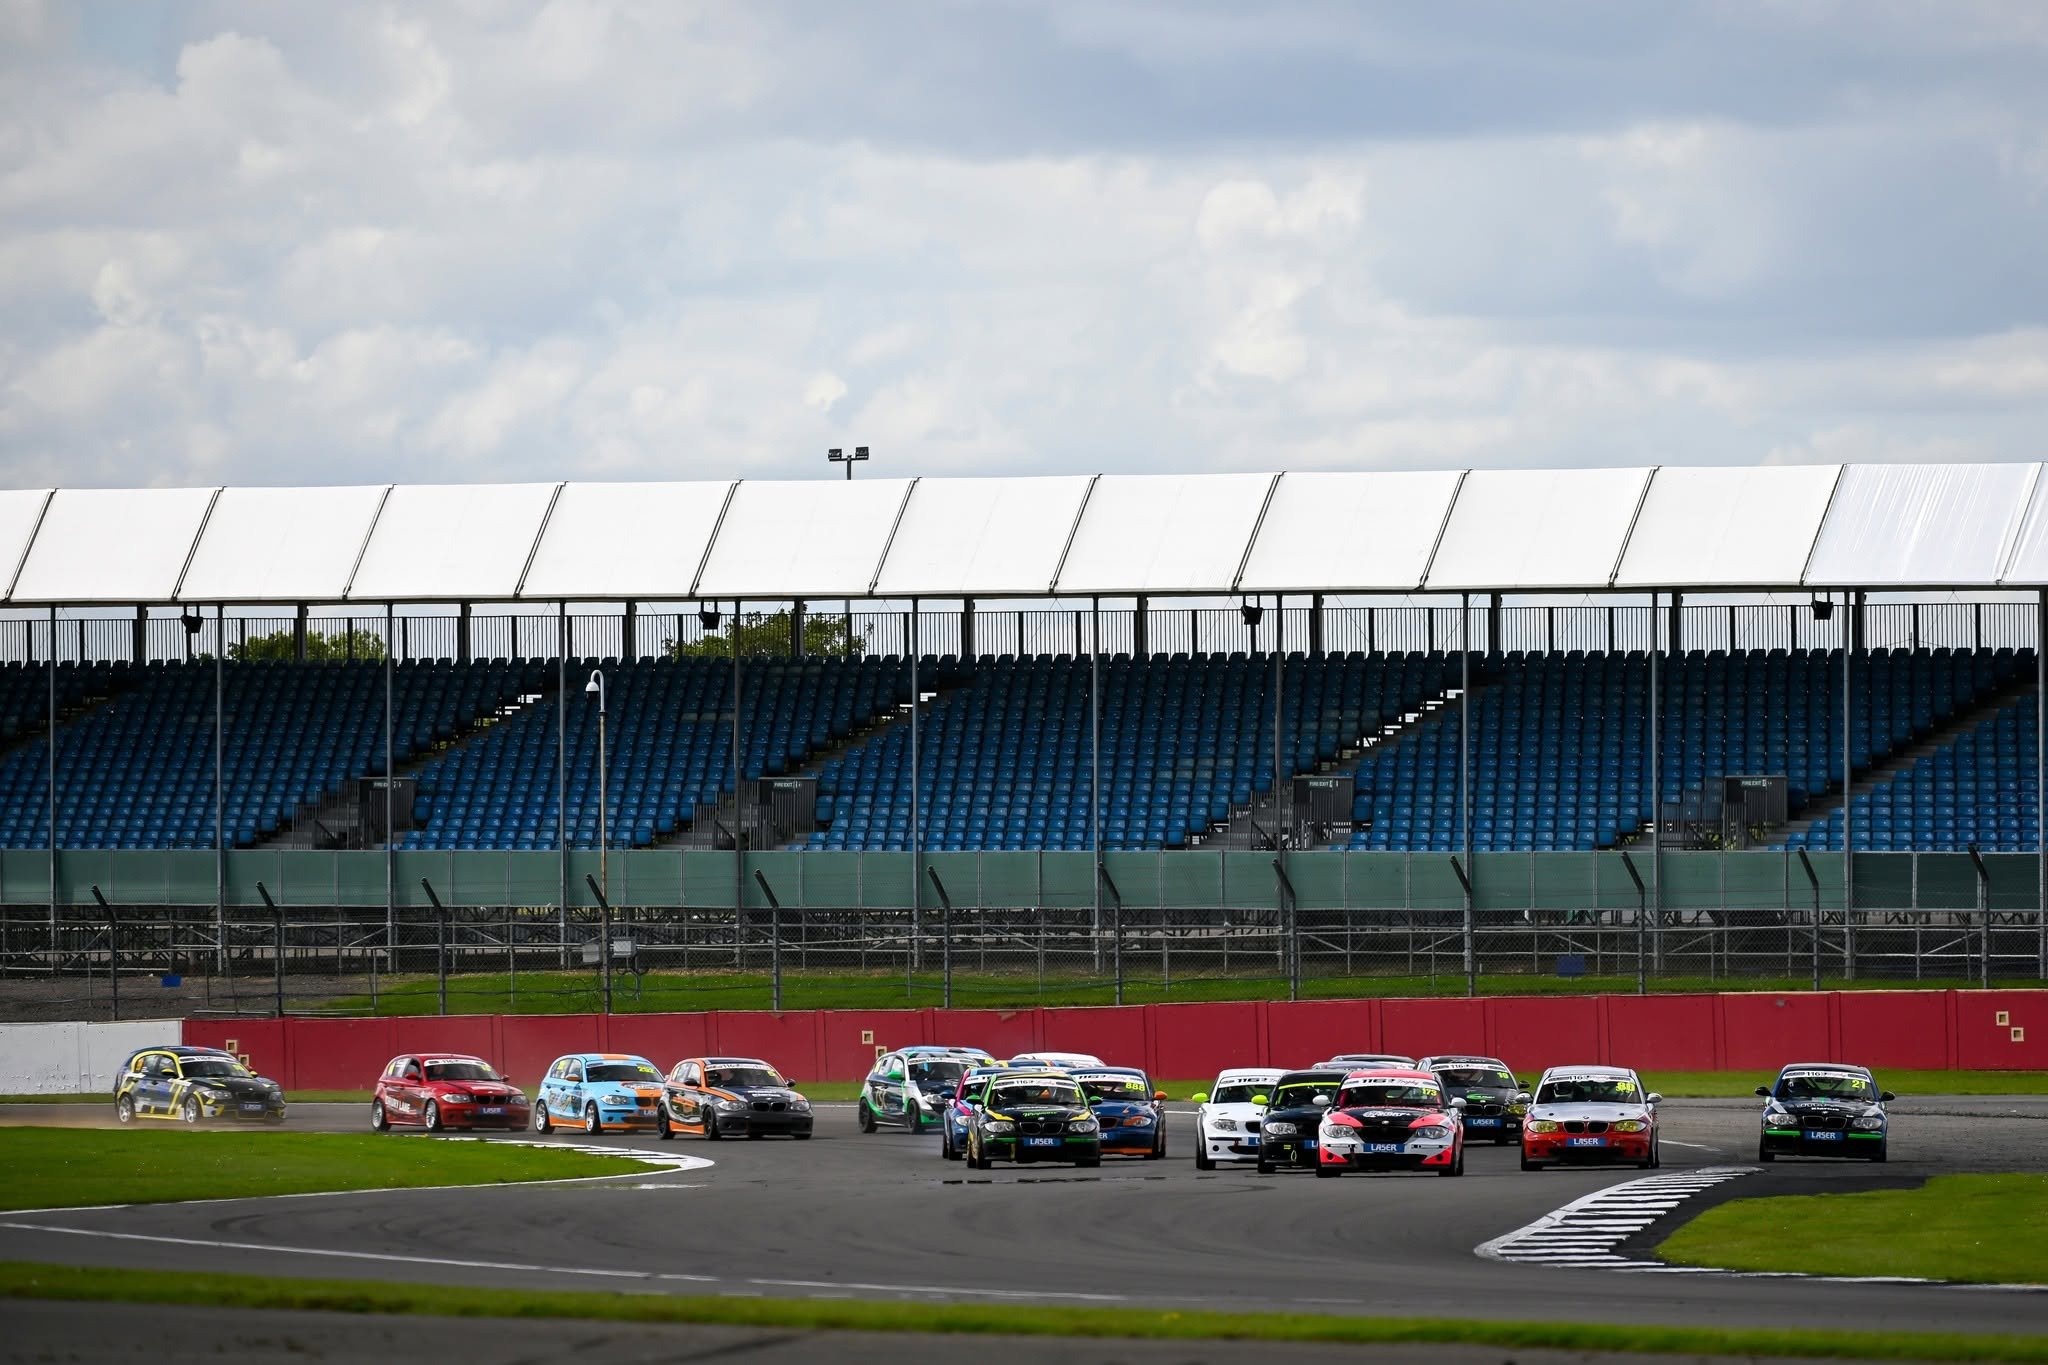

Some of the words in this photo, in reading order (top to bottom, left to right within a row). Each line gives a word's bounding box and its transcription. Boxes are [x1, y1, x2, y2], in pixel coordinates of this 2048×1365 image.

[1125, 1082, 1145, 1092] 888
[1851, 1079, 1866, 1089] 21
[1422, 1087, 1437, 1097] 173
[1811, 1131, 1836, 1139] LASER
[1030, 1137, 1054, 1145] LASER
[1370, 1143, 1397, 1151] LASER
